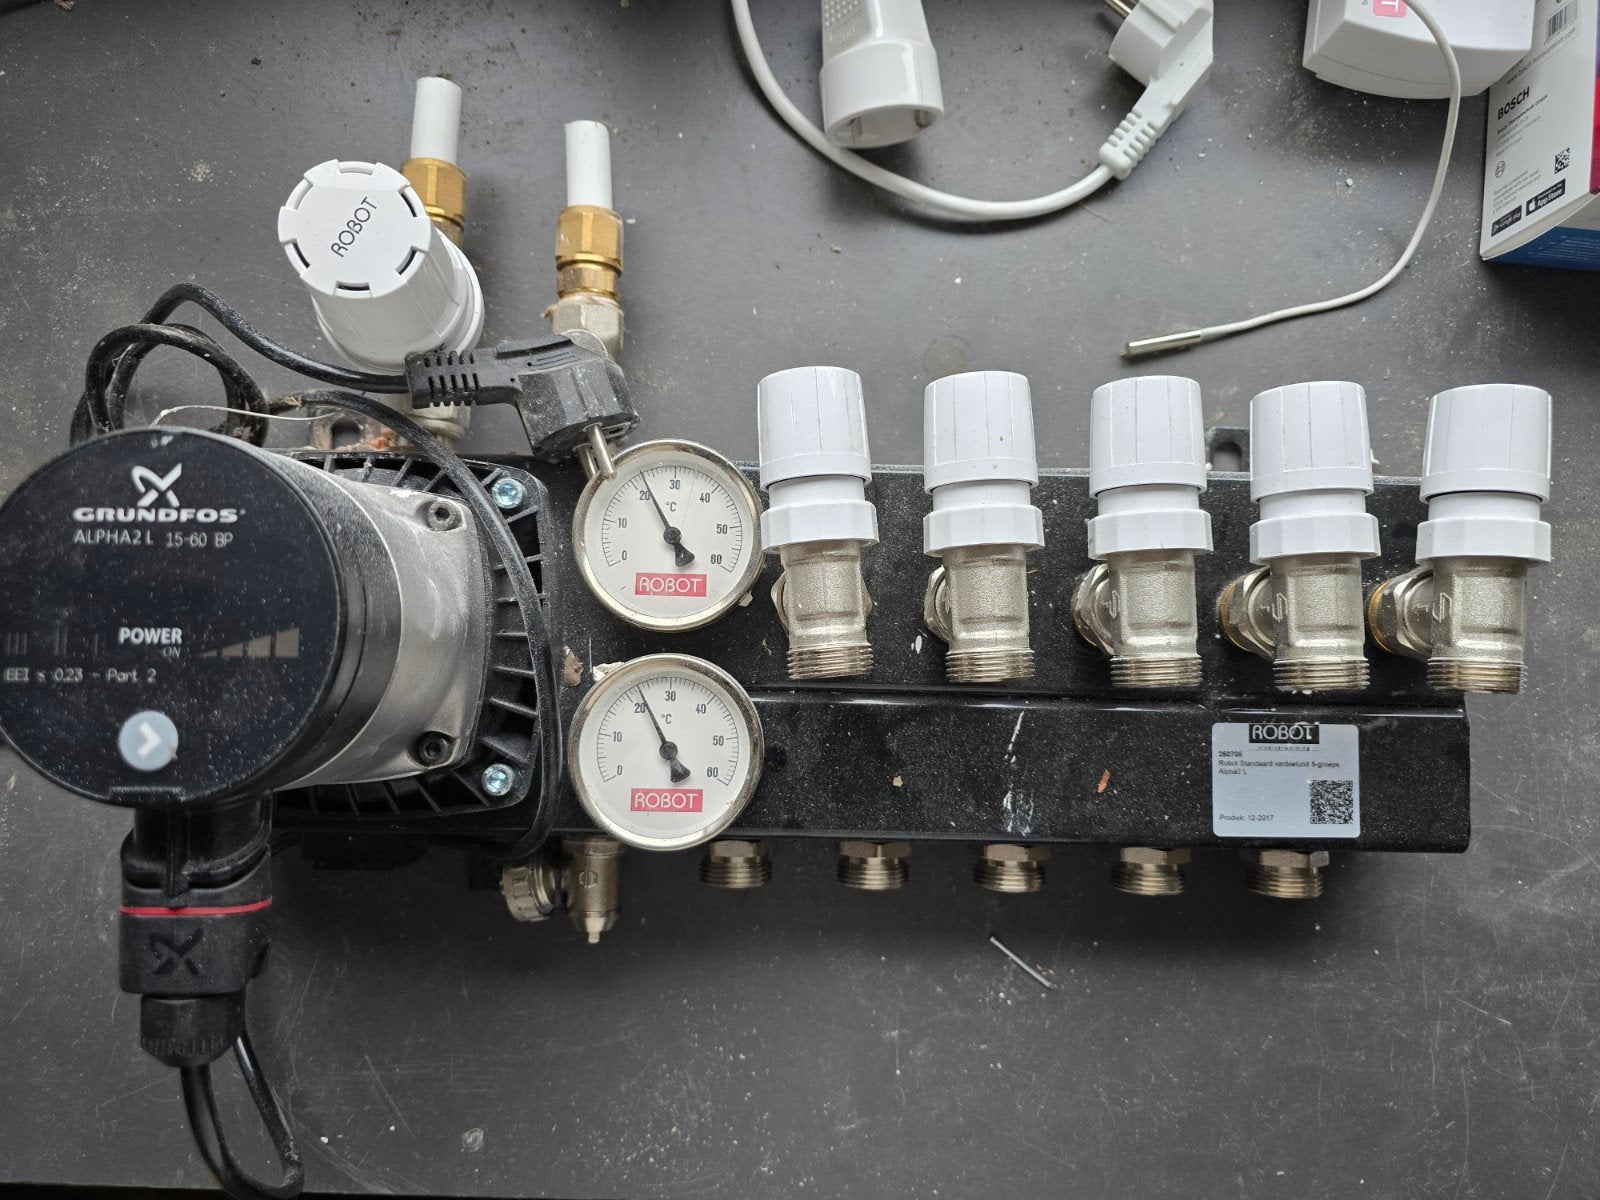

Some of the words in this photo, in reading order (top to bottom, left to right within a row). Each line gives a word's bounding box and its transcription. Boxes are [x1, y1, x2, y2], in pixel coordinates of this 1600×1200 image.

[1497, 86, 1530, 120] BOSCH
[331, 197, 377, 258] ROBOT
[669, 479, 681, 490] 30
[639, 490, 651, 501] 20
[699, 493, 711, 503] 40
[72, 507, 238, 524] GRUNDFOS
[618, 517, 628, 529] 10
[716, 523, 728, 535] 50
[147, 530, 154, 546] L
[166, 531, 208, 548] 15-60
[214, 531, 234, 548] BP
[621, 550, 628, 561] 0
[710, 554, 722, 565] 60
[639, 577, 702, 593] ROBOT
[118, 627, 183, 645] POWER
[106, 667, 139, 683] Part
[147, 668, 157, 683] 2
[664, 690, 677, 702] 30
[634, 702, 646, 714] 20
[695, 703, 707, 715] 40
[612, 731, 622, 743] 10
[1252, 724, 1316, 740] ROBOT
[712, 735, 725, 747] 50
[1240, 760, 1273, 768] Standaard
[617, 765, 623, 776] 0
[634, 792, 699, 809] ROBOT
